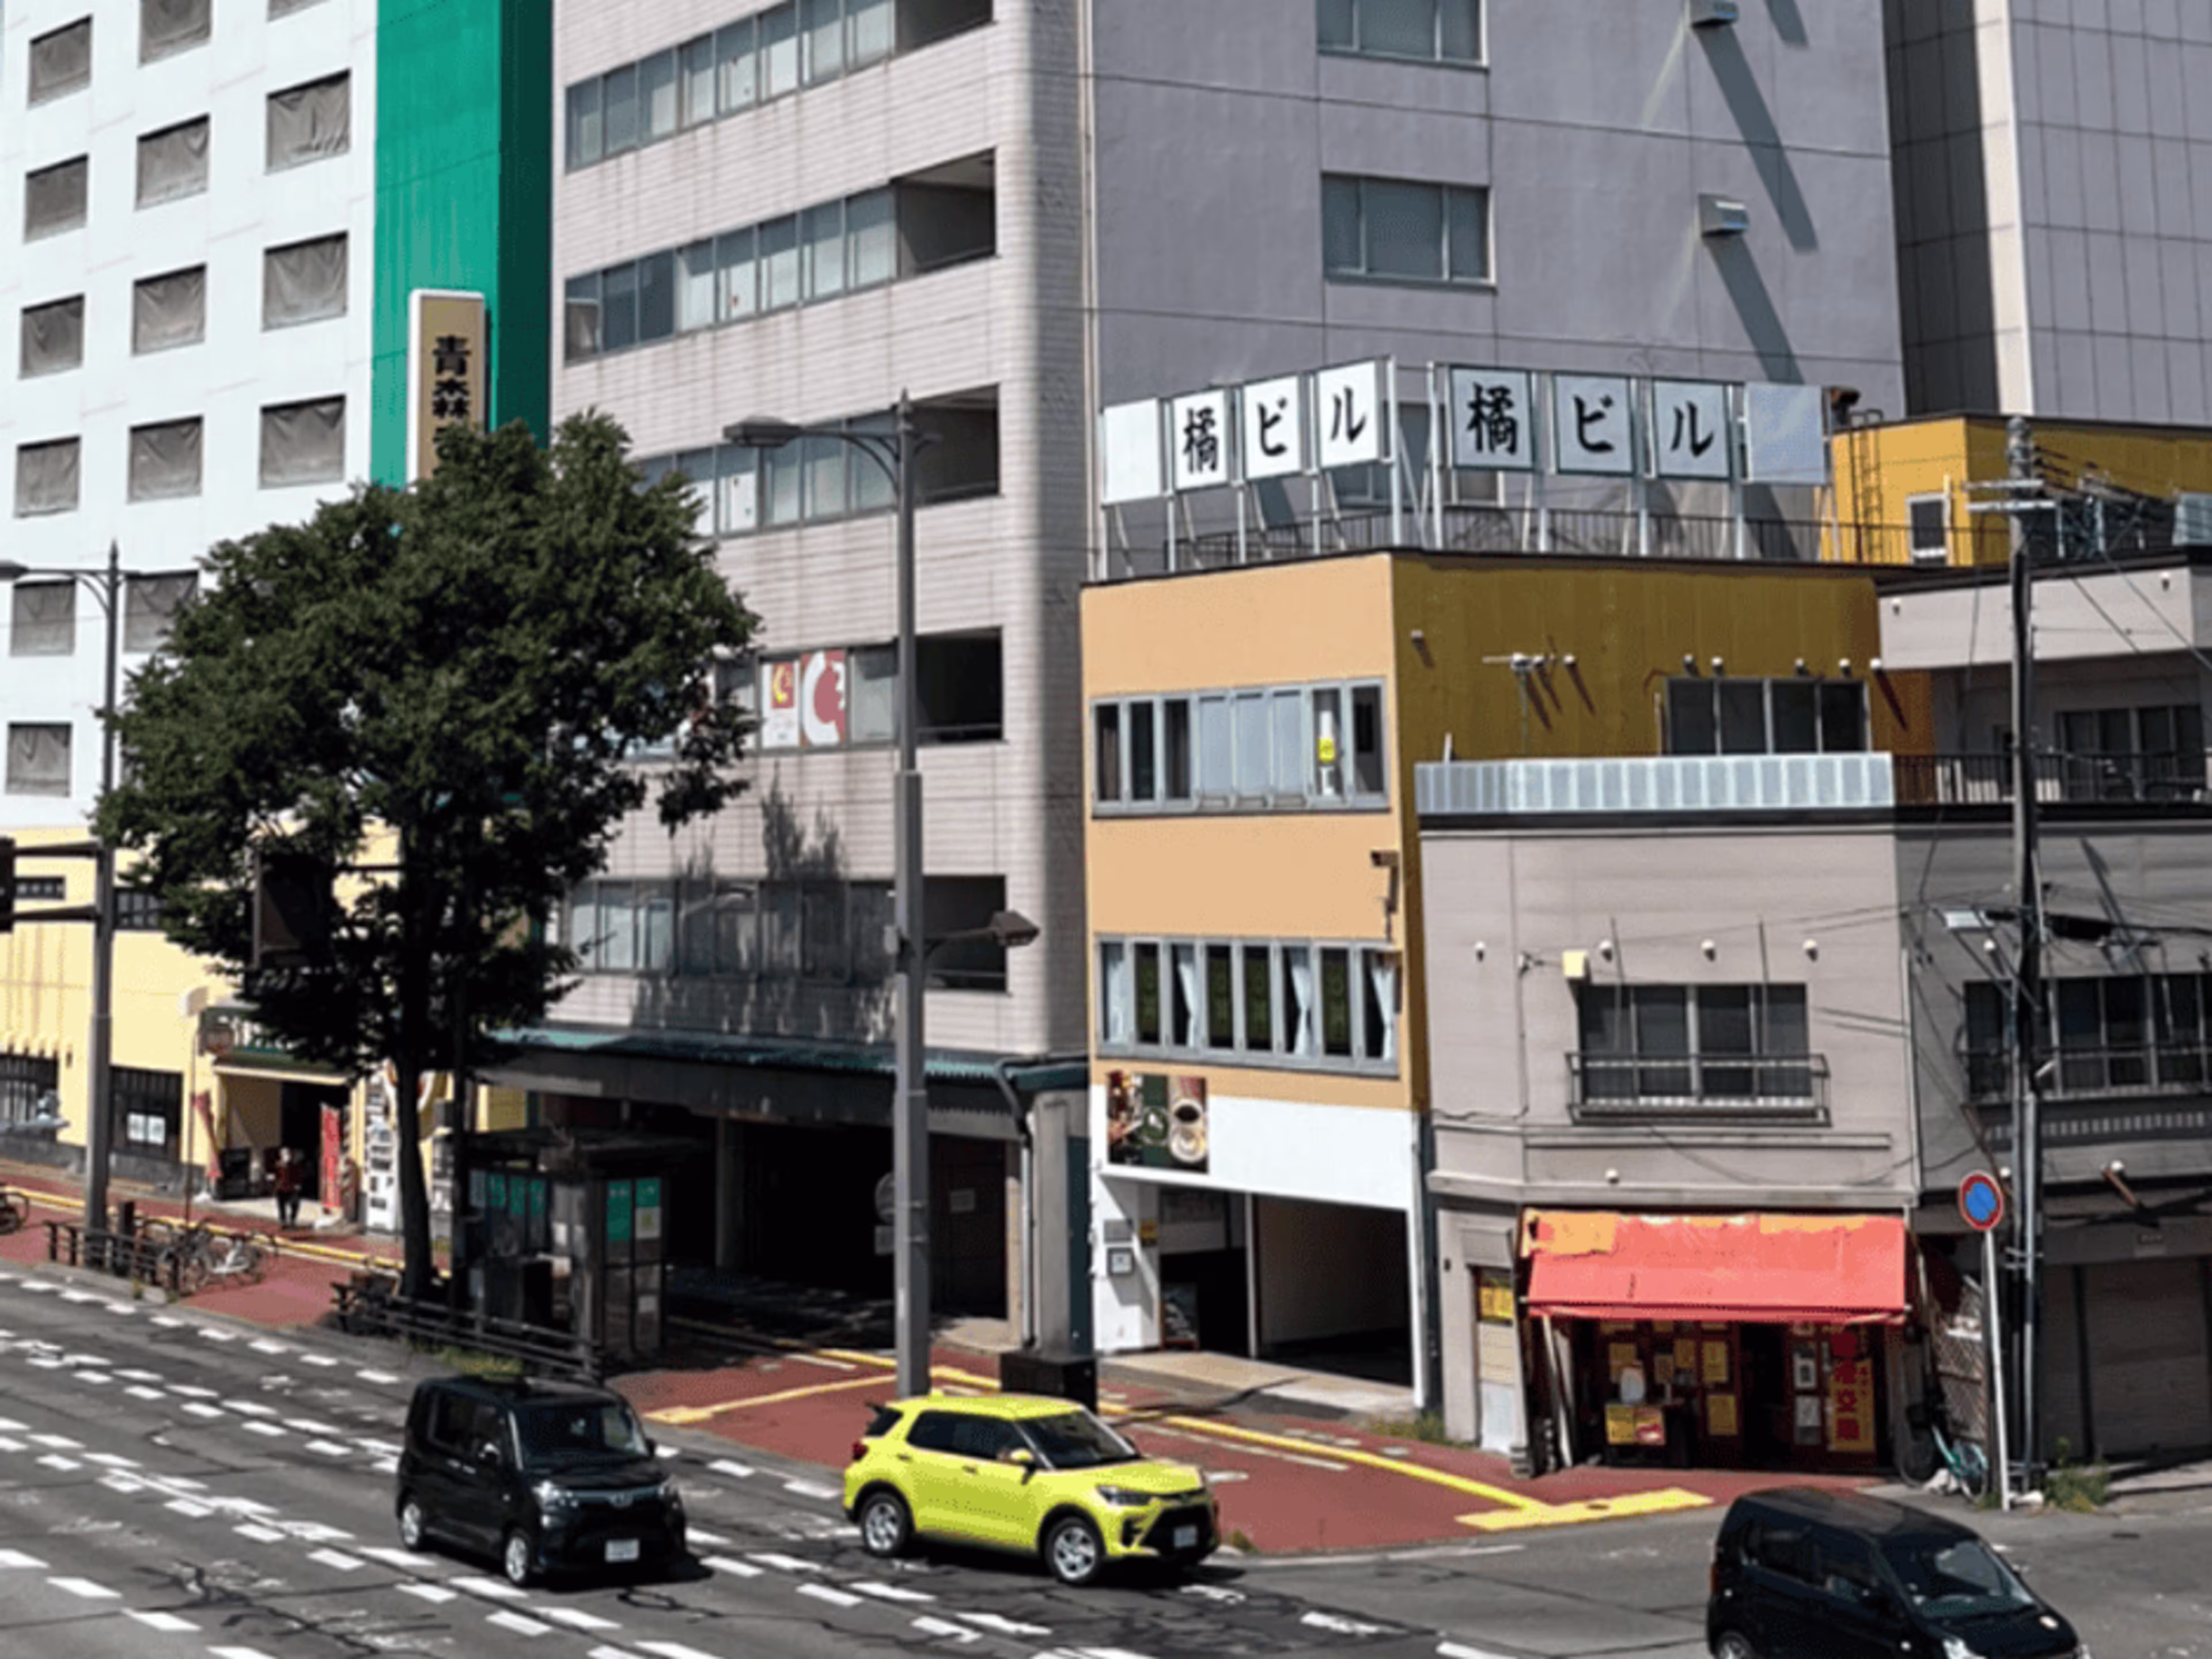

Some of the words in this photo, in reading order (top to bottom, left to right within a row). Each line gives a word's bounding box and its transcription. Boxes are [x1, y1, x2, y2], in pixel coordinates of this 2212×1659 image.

[433, 335, 471, 446] 青森
[1467, 382, 1714, 457] 橘ビル
